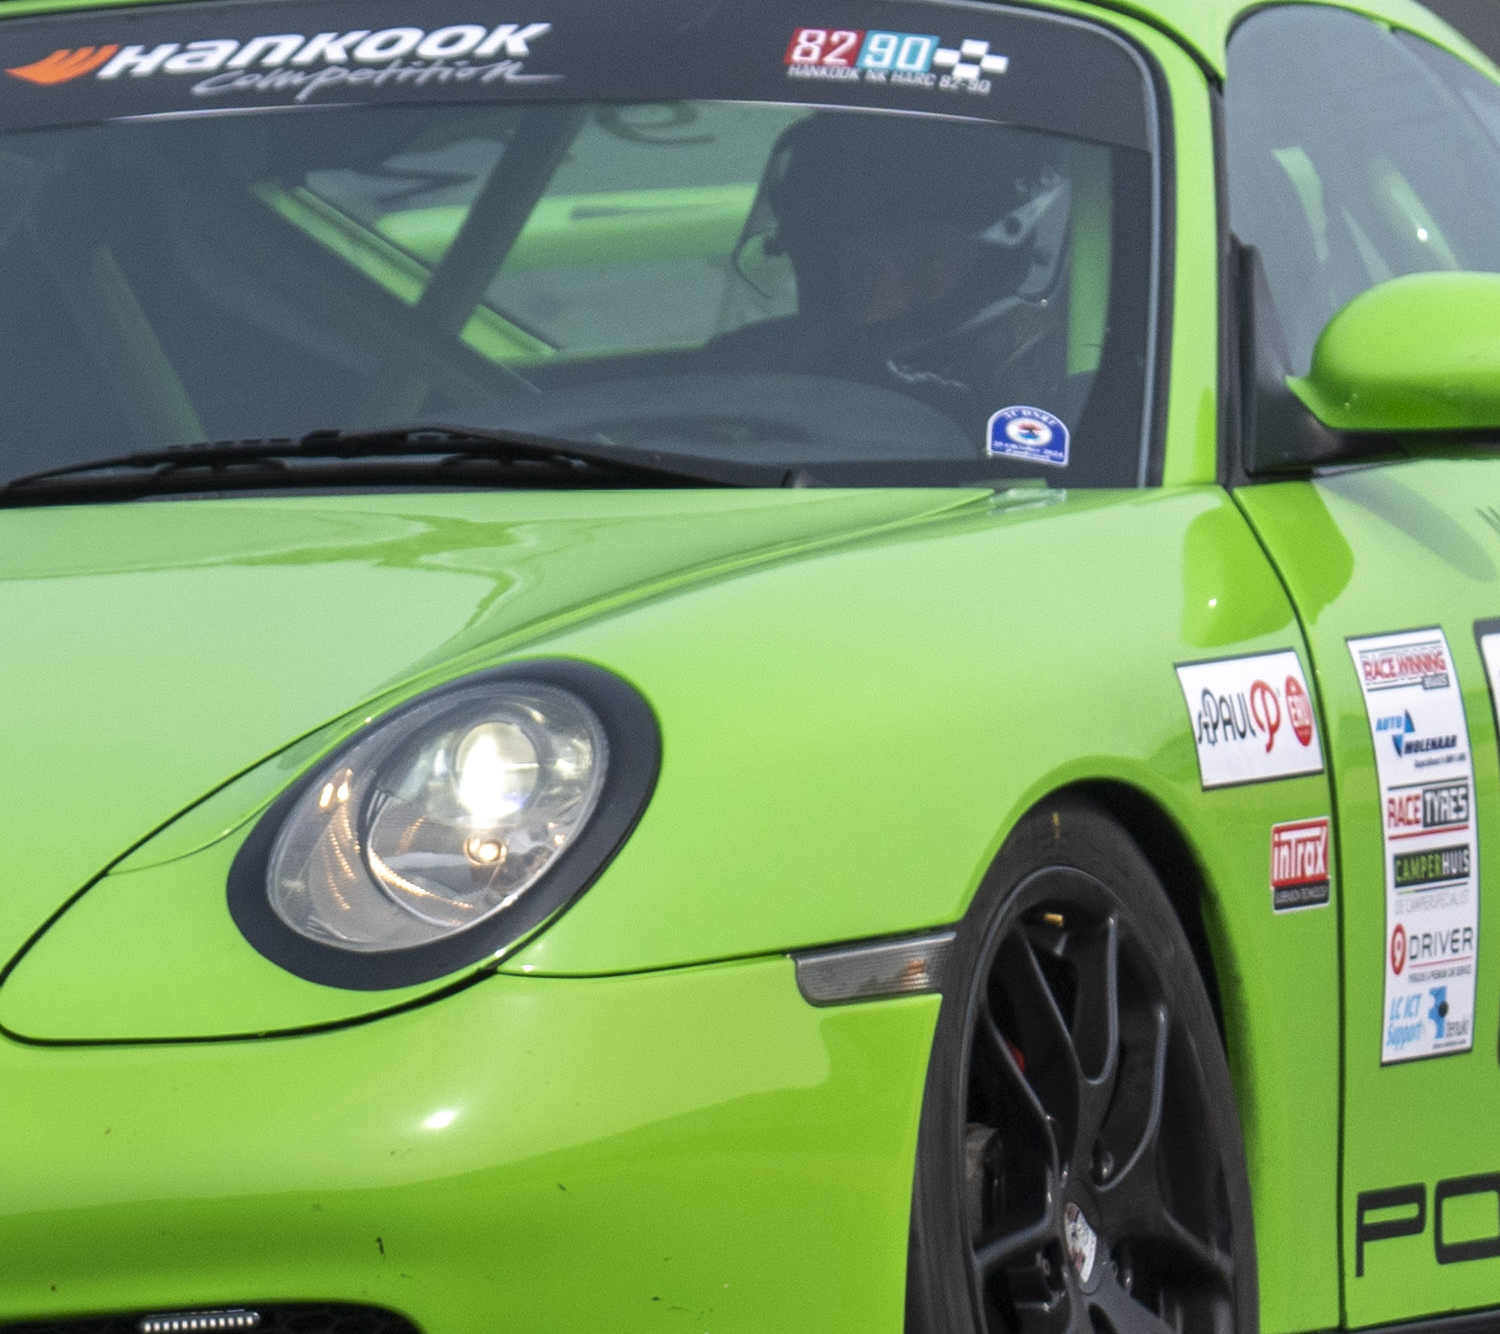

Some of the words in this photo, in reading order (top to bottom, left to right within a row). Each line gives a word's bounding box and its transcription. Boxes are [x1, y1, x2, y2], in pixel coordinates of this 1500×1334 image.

[790, 28, 858, 65] 82
[863, 33, 932, 72] 90
[787, 64, 860, 81] HANKOOK
[864, 68, 888, 84] NK
[938, 73, 993, 96] 82-90
[1361, 656, 1397, 682] RACE
[1397, 649, 1447, 677] WINNING
[1375, 715, 1403, 732] AUTO
[1403, 734, 1458, 755] MOLENAAR
[1387, 794, 1422, 829] RACE
[1424, 786, 1468, 825] TYRES
[1395, 848, 1470, 884] CAMPERHUIS
[1409, 926, 1473, 961] DRIVER
